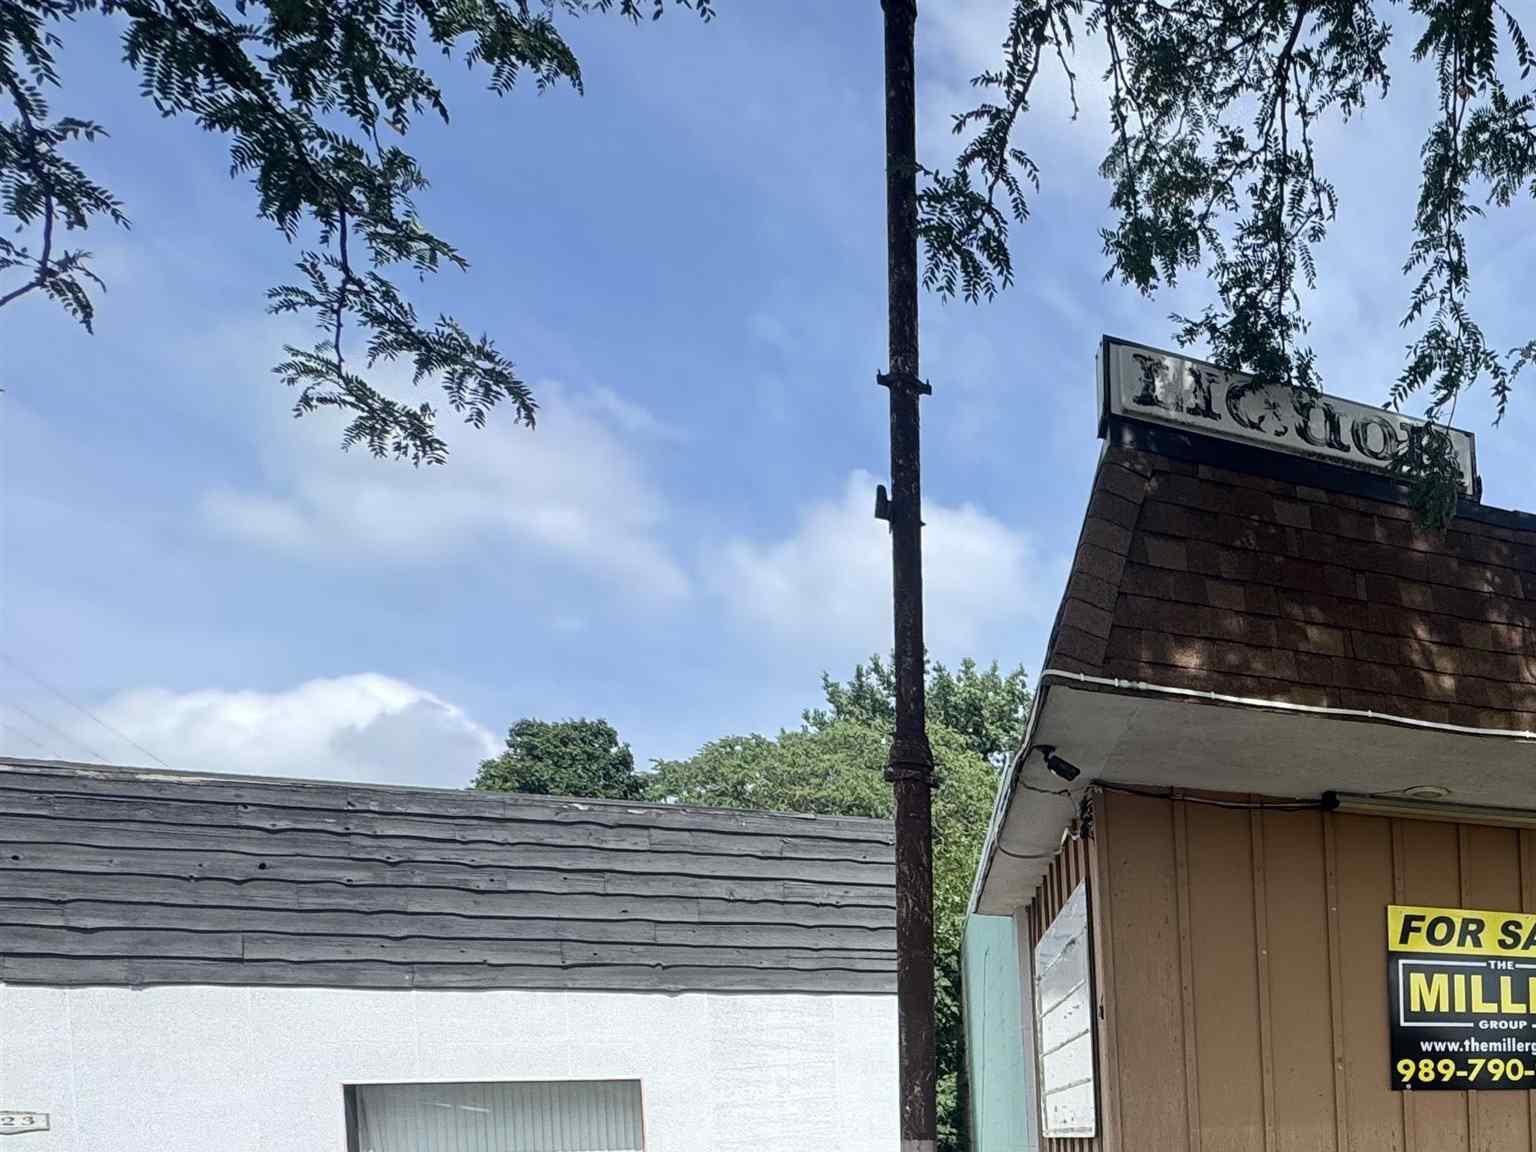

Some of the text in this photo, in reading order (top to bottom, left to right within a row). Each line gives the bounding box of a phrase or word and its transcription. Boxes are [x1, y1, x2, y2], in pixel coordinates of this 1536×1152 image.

[1399, 914, 1485, 948] FOR
[1488, 960, 1515, 970] THE
[1478, 1020, 1528, 1030] GROUP
